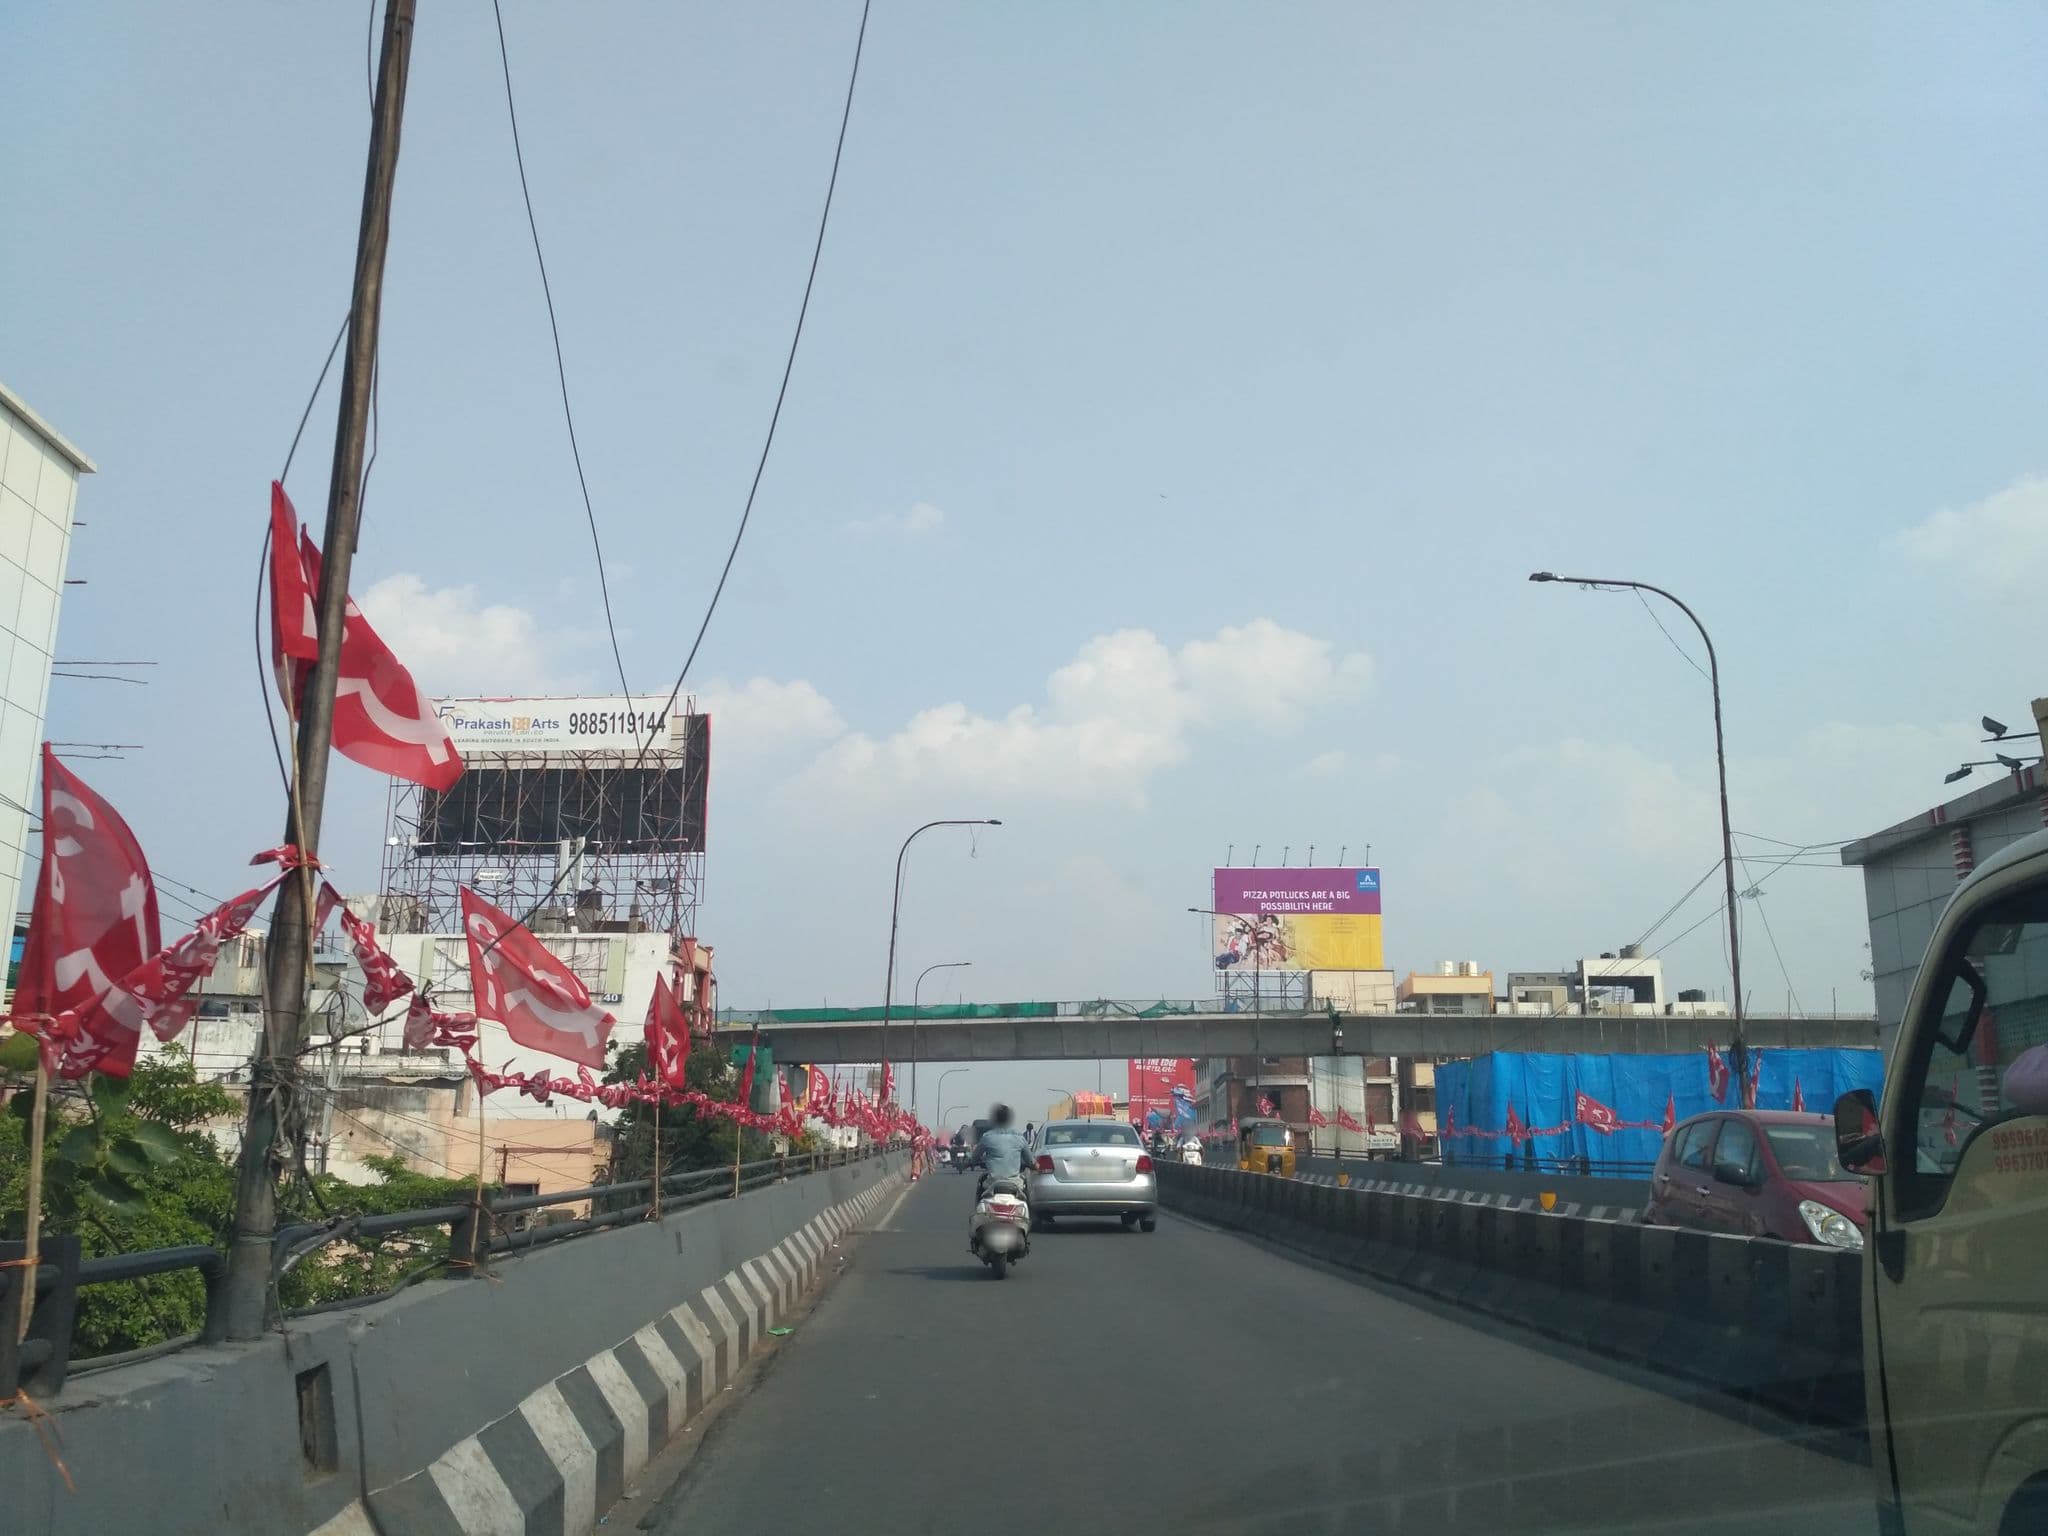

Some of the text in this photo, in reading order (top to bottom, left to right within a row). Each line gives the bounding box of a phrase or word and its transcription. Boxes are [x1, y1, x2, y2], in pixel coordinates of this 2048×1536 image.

[455, 718, 560, 730] Prakash Arts
[569, 712, 666, 734] 9885119144
[1243, 891, 1350, 899] PIZZA POTLUCKS ARE A BIG
[1261, 902, 1310, 911] POSSIBILITY
[603, 994, 618, 1002] 40
